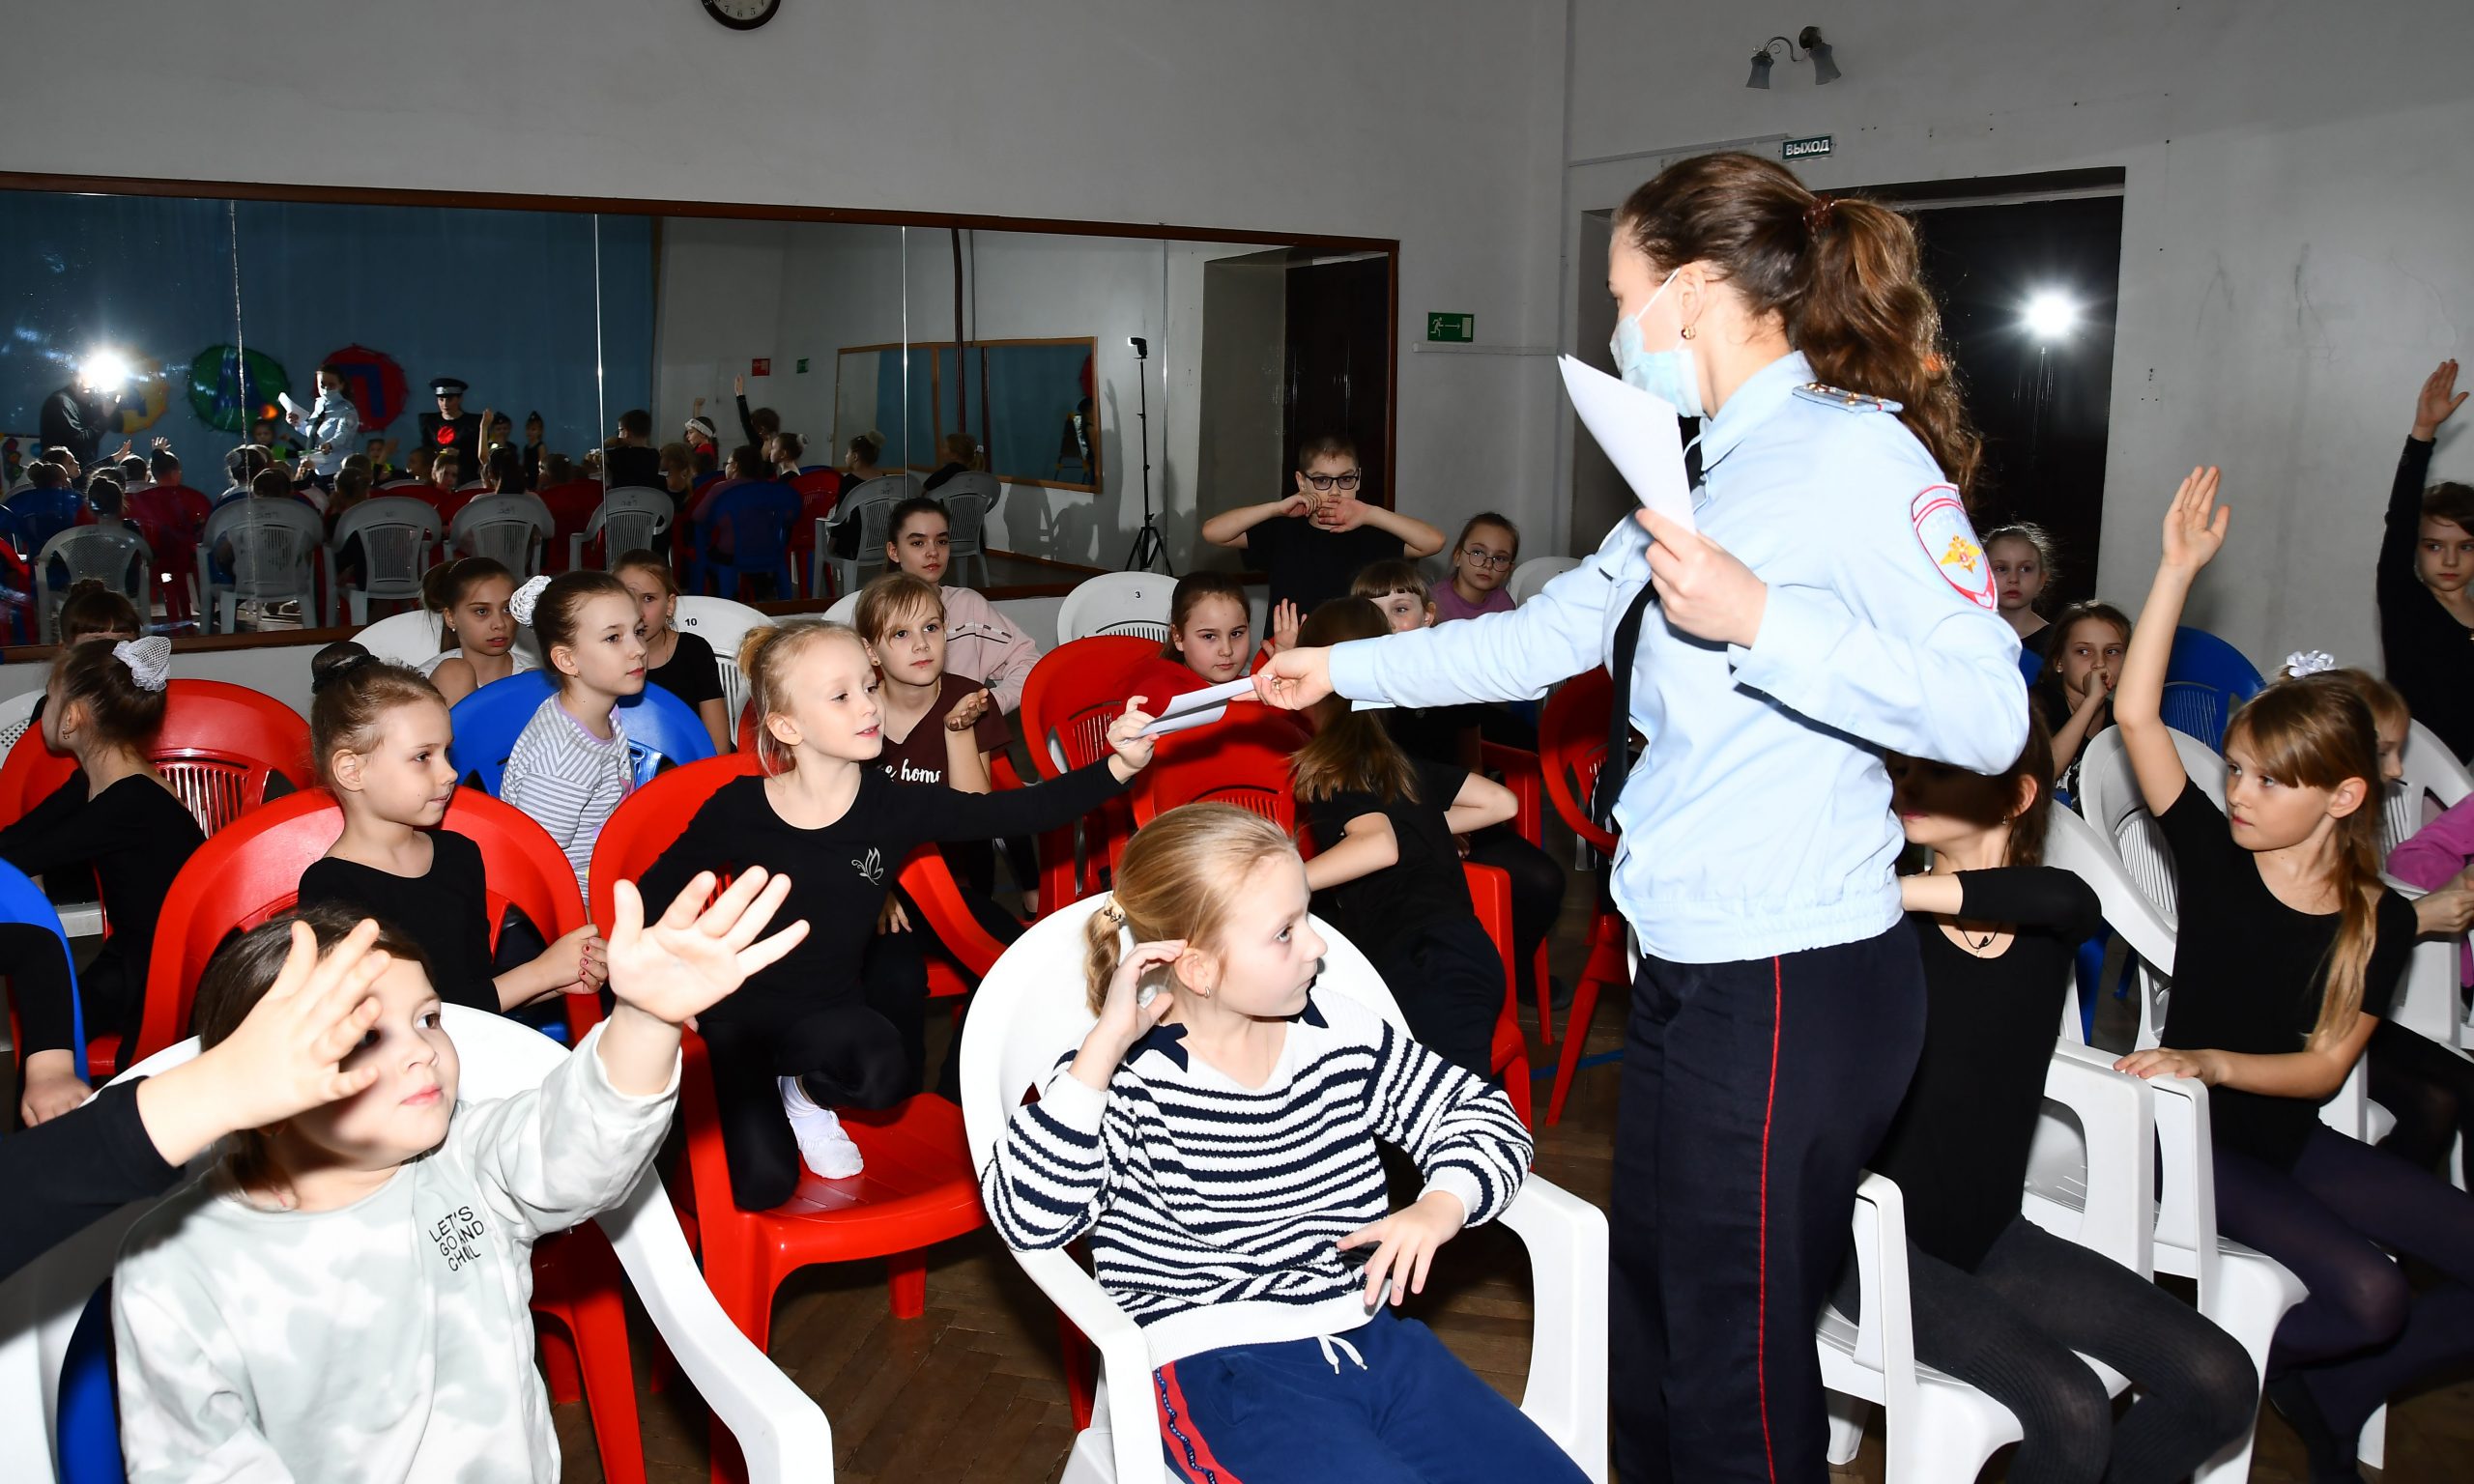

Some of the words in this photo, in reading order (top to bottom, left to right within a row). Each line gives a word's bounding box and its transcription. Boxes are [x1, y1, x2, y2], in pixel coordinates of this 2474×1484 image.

[736, 9, 743, 17] 6
[1785, 139, 1829, 156] ВЫХОД
[1135, 590, 1141, 599] 3
[684, 618, 698, 627] 10
[428, 1206, 474, 1243] LET'S
[440, 1235, 458, 1257] GO
[457, 1220, 485, 1244] AND
